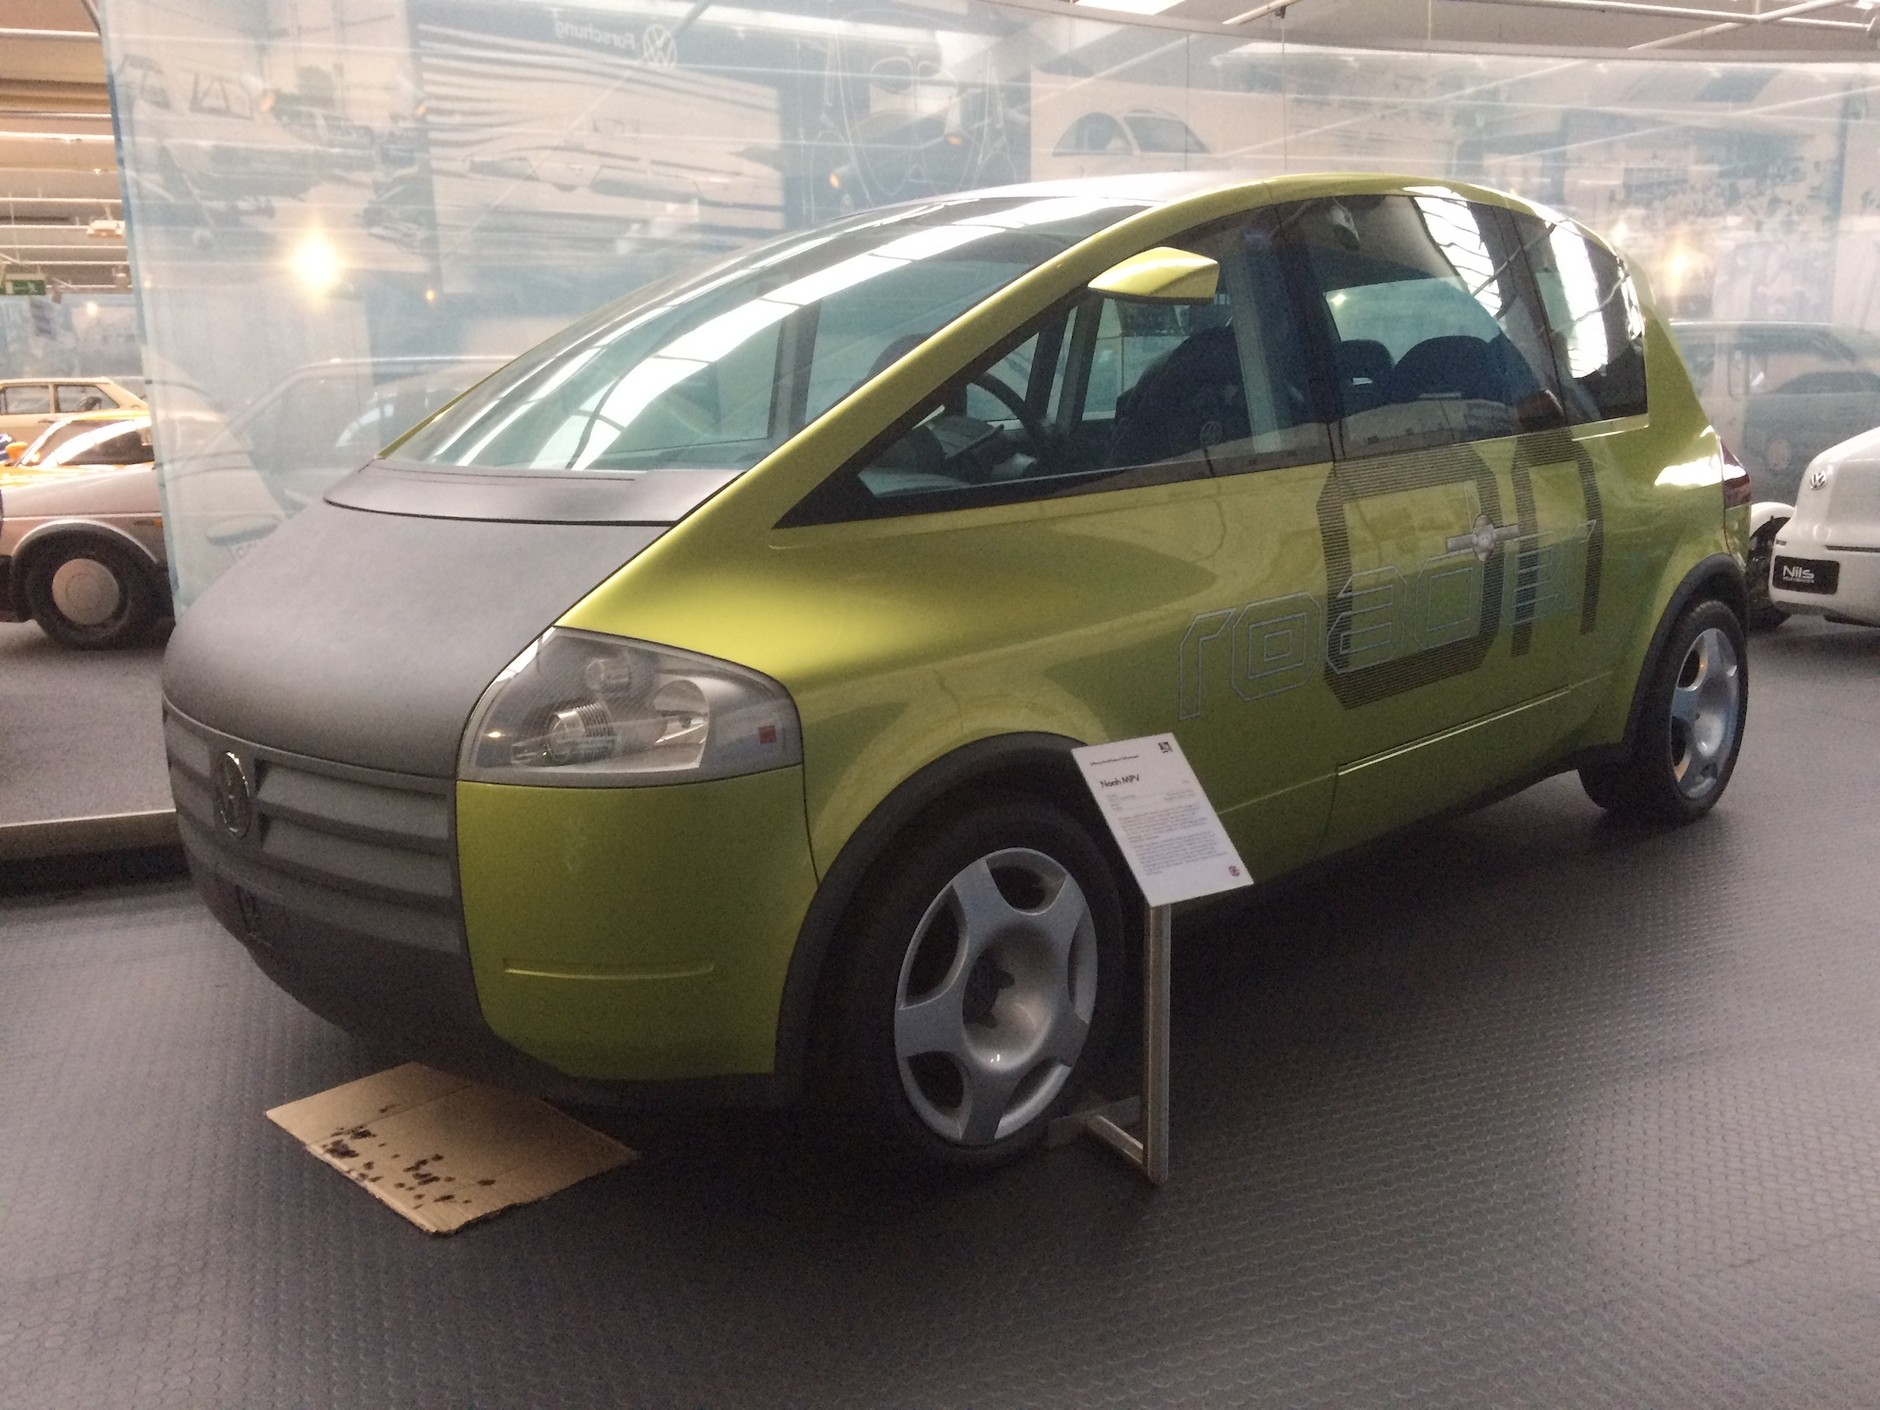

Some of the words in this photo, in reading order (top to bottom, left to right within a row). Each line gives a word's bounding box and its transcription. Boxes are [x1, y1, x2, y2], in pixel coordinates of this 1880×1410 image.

[1782, 565, 1815, 579] Nils
[1100, 777, 1122, 788] Noah
[1121, 773, 1140, 784] MPV
